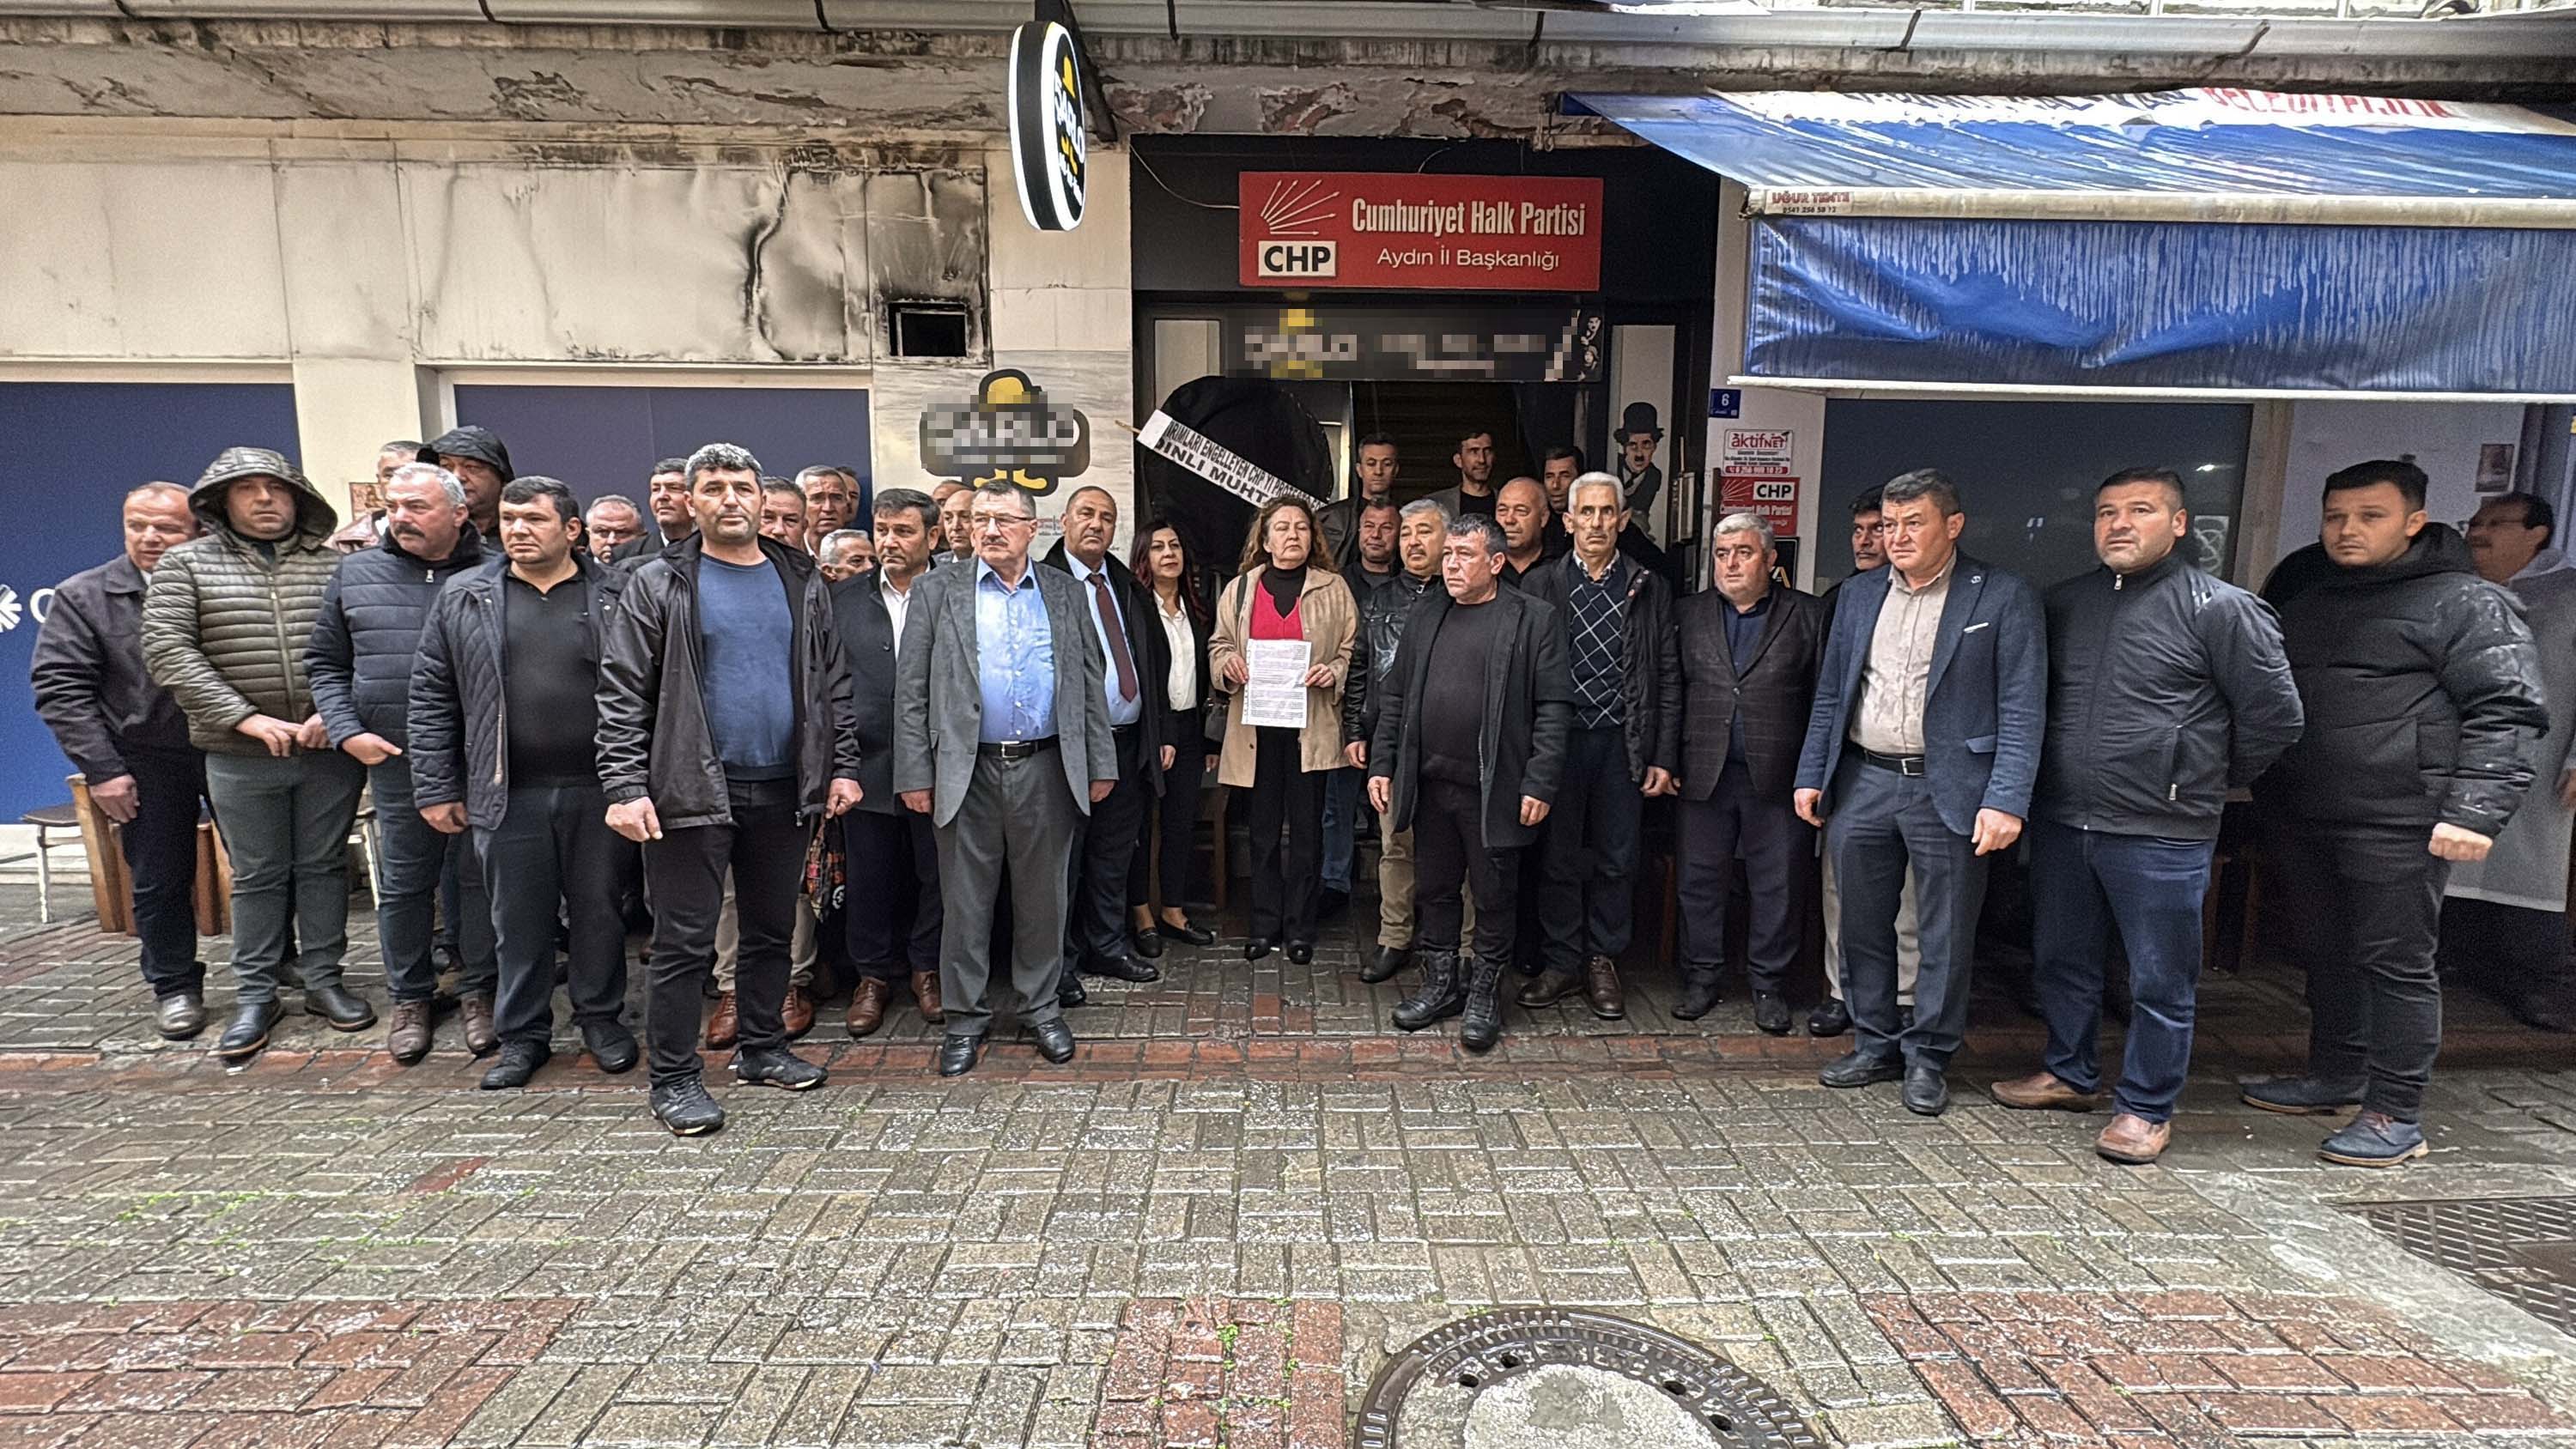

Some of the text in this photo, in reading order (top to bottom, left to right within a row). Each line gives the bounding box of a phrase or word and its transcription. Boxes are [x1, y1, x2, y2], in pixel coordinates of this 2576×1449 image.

[1352, 198, 1586, 238] Cumhuriyet Halk Partisi
[1264, 246, 1331, 272] CHP
[1376, 245, 1558, 270] Aydın İl Başkanlığı
[1722, 393, 1730, 406] 6
[1200, 440, 1250, 478] ENGELLEYEN
[1249, 465, 1266, 486] CHP
[1757, 484, 1792, 498] CHP
